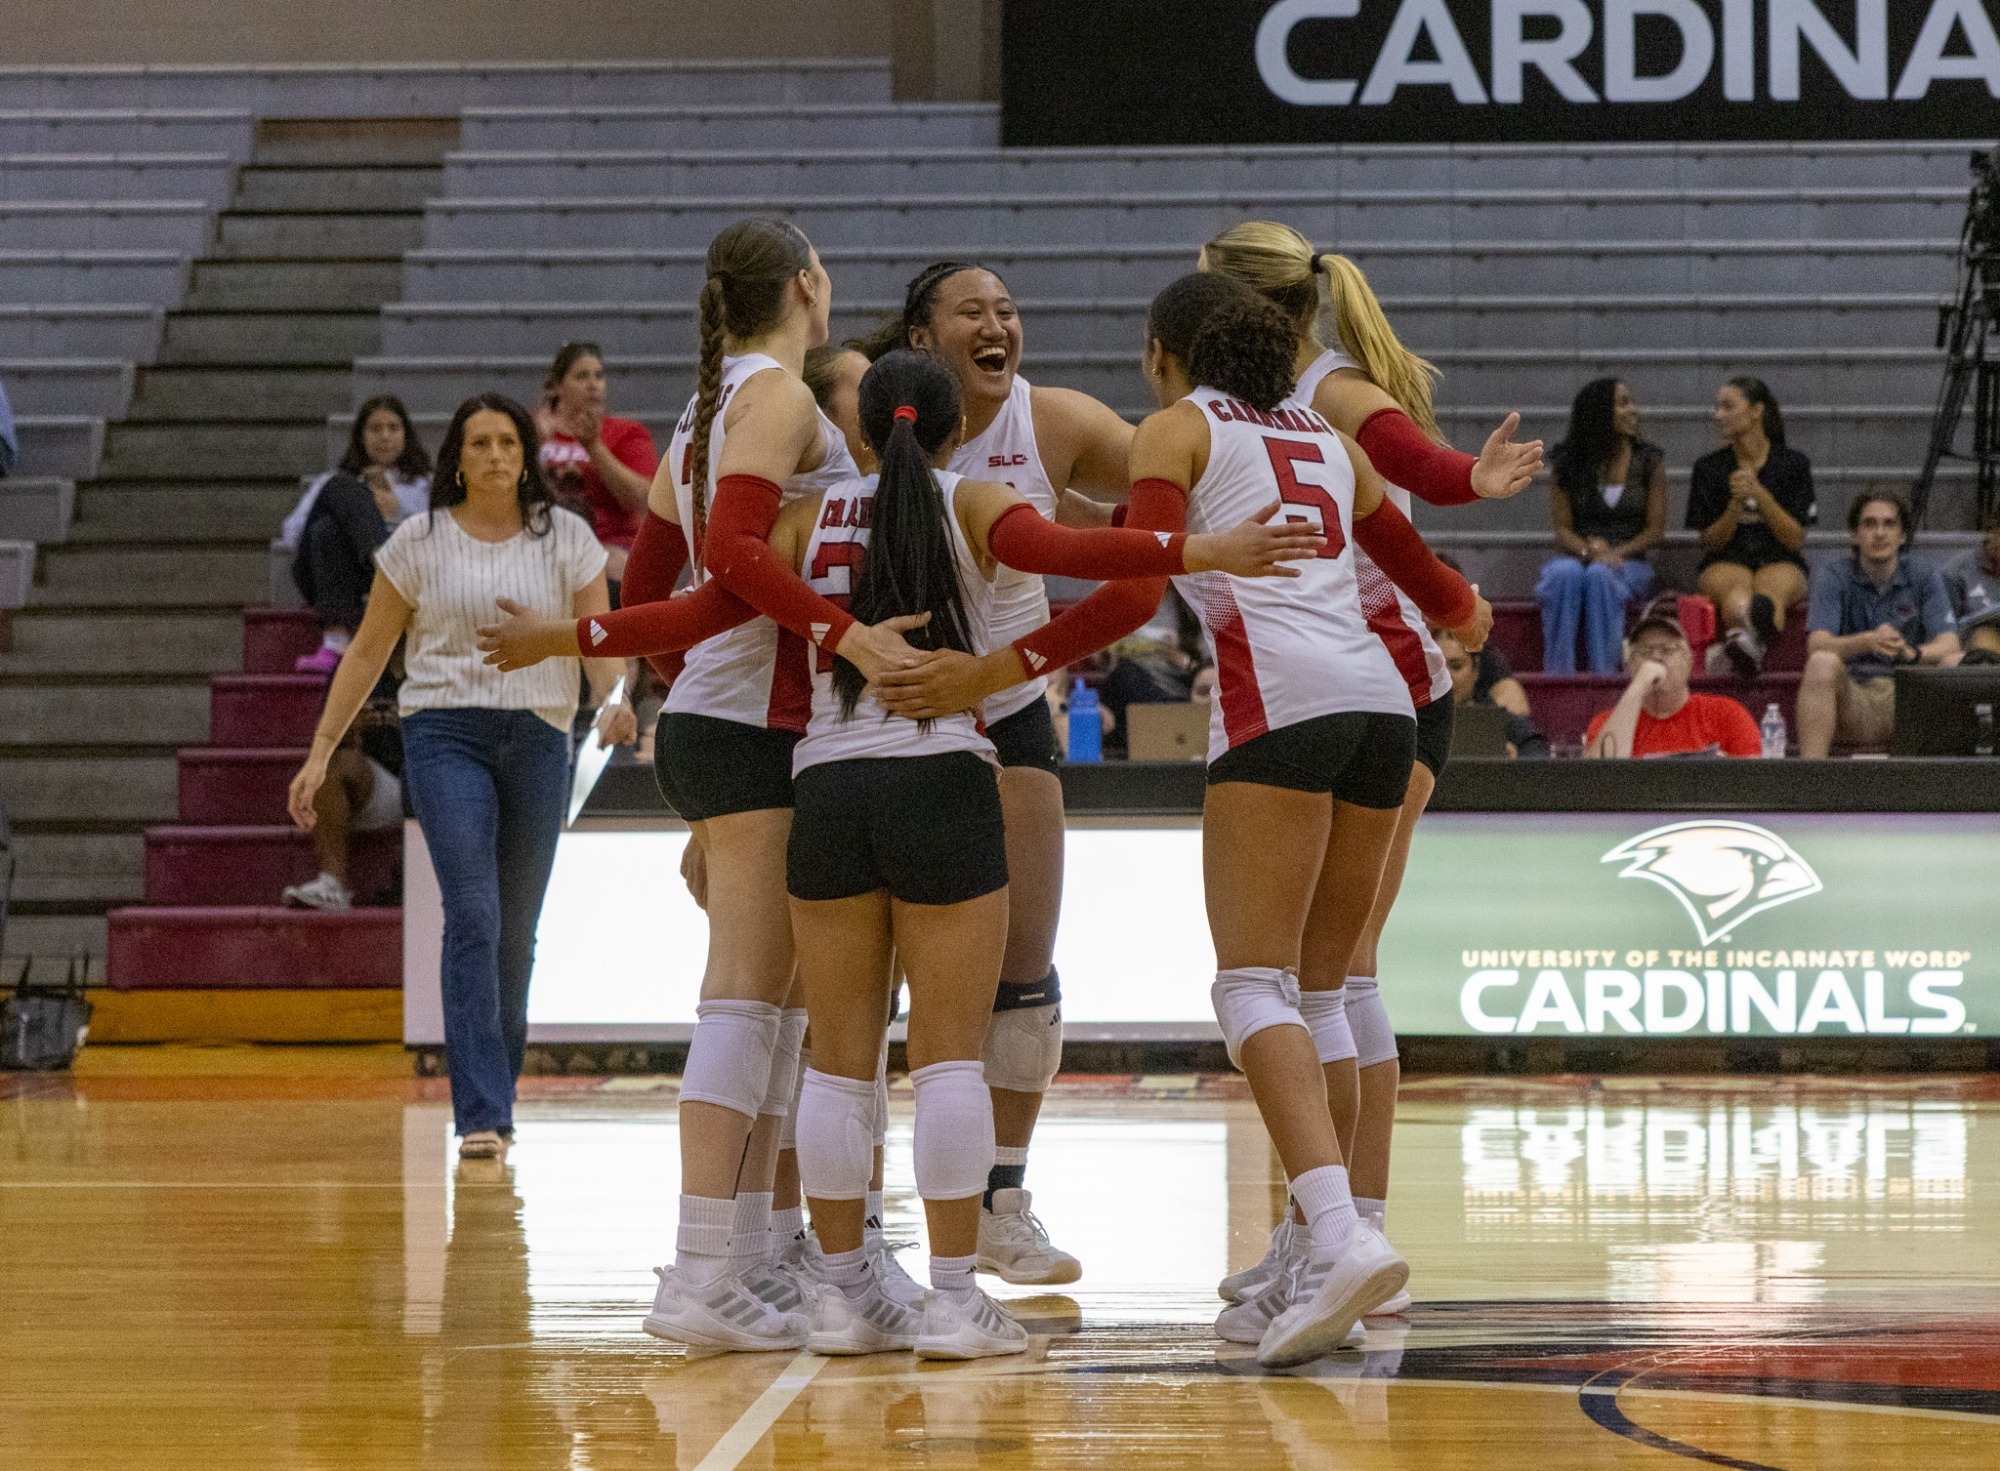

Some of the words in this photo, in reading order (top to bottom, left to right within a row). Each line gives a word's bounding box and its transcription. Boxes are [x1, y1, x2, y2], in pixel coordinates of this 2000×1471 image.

[1254, 0, 2000, 104] CARDINA
[988, 454, 1028, 468] SLC
[1261, 435, 1346, 559] 5
[1461, 949, 1615, 968] UNIVERSITY
[1625, 949, 1660, 968] OF
[1668, 949, 1719, 968] THE
[1726, 949, 1876, 968] INCARNATE
[1460, 969, 1967, 1034] CARDINALS
